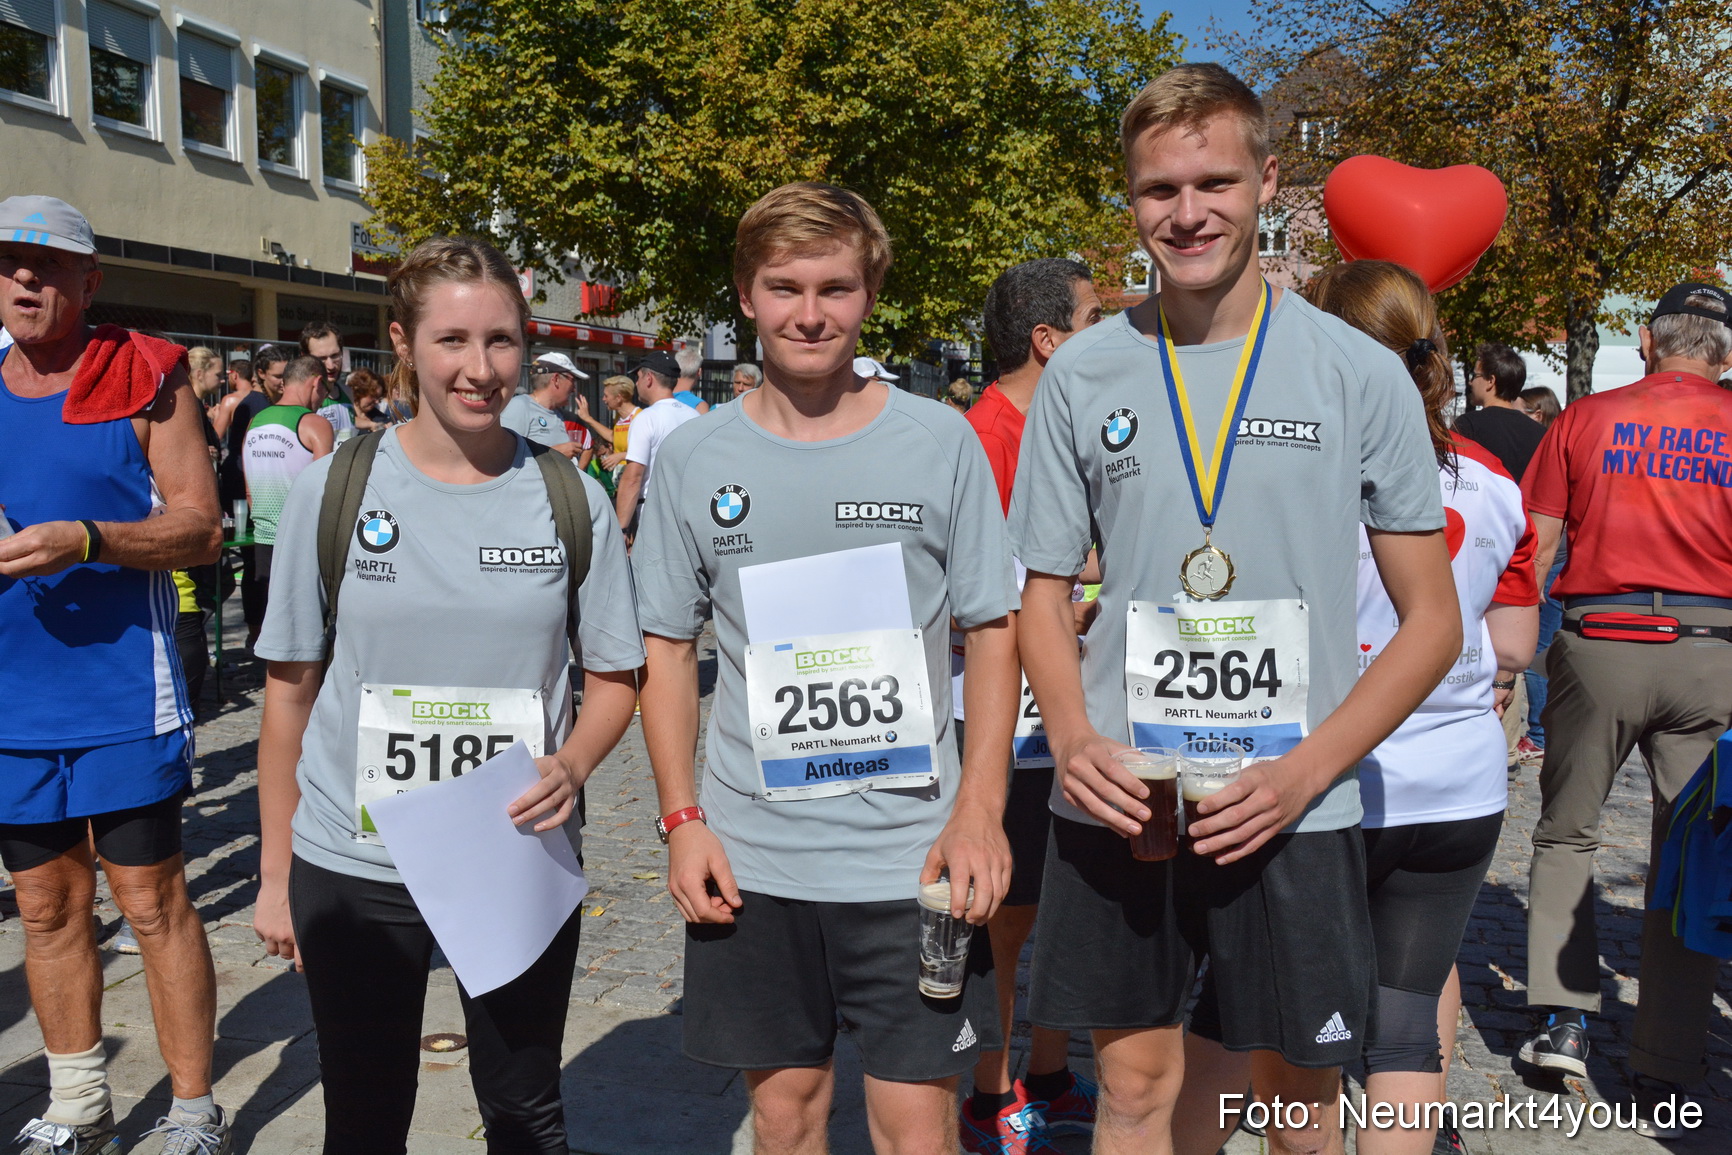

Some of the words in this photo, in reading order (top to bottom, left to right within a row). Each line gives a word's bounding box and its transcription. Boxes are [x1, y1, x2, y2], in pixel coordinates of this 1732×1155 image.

[353, 225, 376, 247] Fot
[247, 436, 257, 448] SC
[258, 433, 294, 450] Kemmern
[1235, 439, 1254, 447] pired
[1290, 442, 1321, 452] concepts
[1612, 422, 1652, 450] MY
[1658, 426, 1730, 458] RACE.
[252, 450, 285, 459] RUNNING
[1602, 449, 1641, 475] MY
[1105, 456, 1140, 477] PARTL
[1108, 467, 1141, 486] Neumarkt
[1444, 481, 1479, 492] GRADU
[835, 502, 924, 525] BOCK
[835, 521, 864, 529] inspired
[898, 524, 923, 532] concepts
[712, 533, 753, 548] PARTL
[1475, 537, 1496, 549] DEHN
[479, 546, 563, 566] BOCK
[714, 545, 753, 556] Neumarkt
[355, 559, 397, 574] PARTL
[356, 571, 396, 583] Neumarkt
[1178, 616, 1256, 636] BOCK
[795, 646, 873, 669] BOCK
[797, 668, 820, 676] inspired
[1154, 648, 1282, 701] 2564
[1137, 687, 1143, 696] C
[412, 701, 491, 719] BOCK
[775, 674, 903, 734] 2563
[1165, 708, 1202, 719] PARTL
[1205, 709, 1257, 720] Neumarkt
[761, 727, 767, 737] C
[791, 740, 828, 751] PARTL
[830, 734, 881, 748] Neumarkt
[1183, 731, 1254, 753] Tobias
[368, 769, 374, 779] S
[804, 757, 890, 780] Andreas
[952, 1034, 976, 1052] adidas
[1315, 1030, 1352, 1043] adidas
